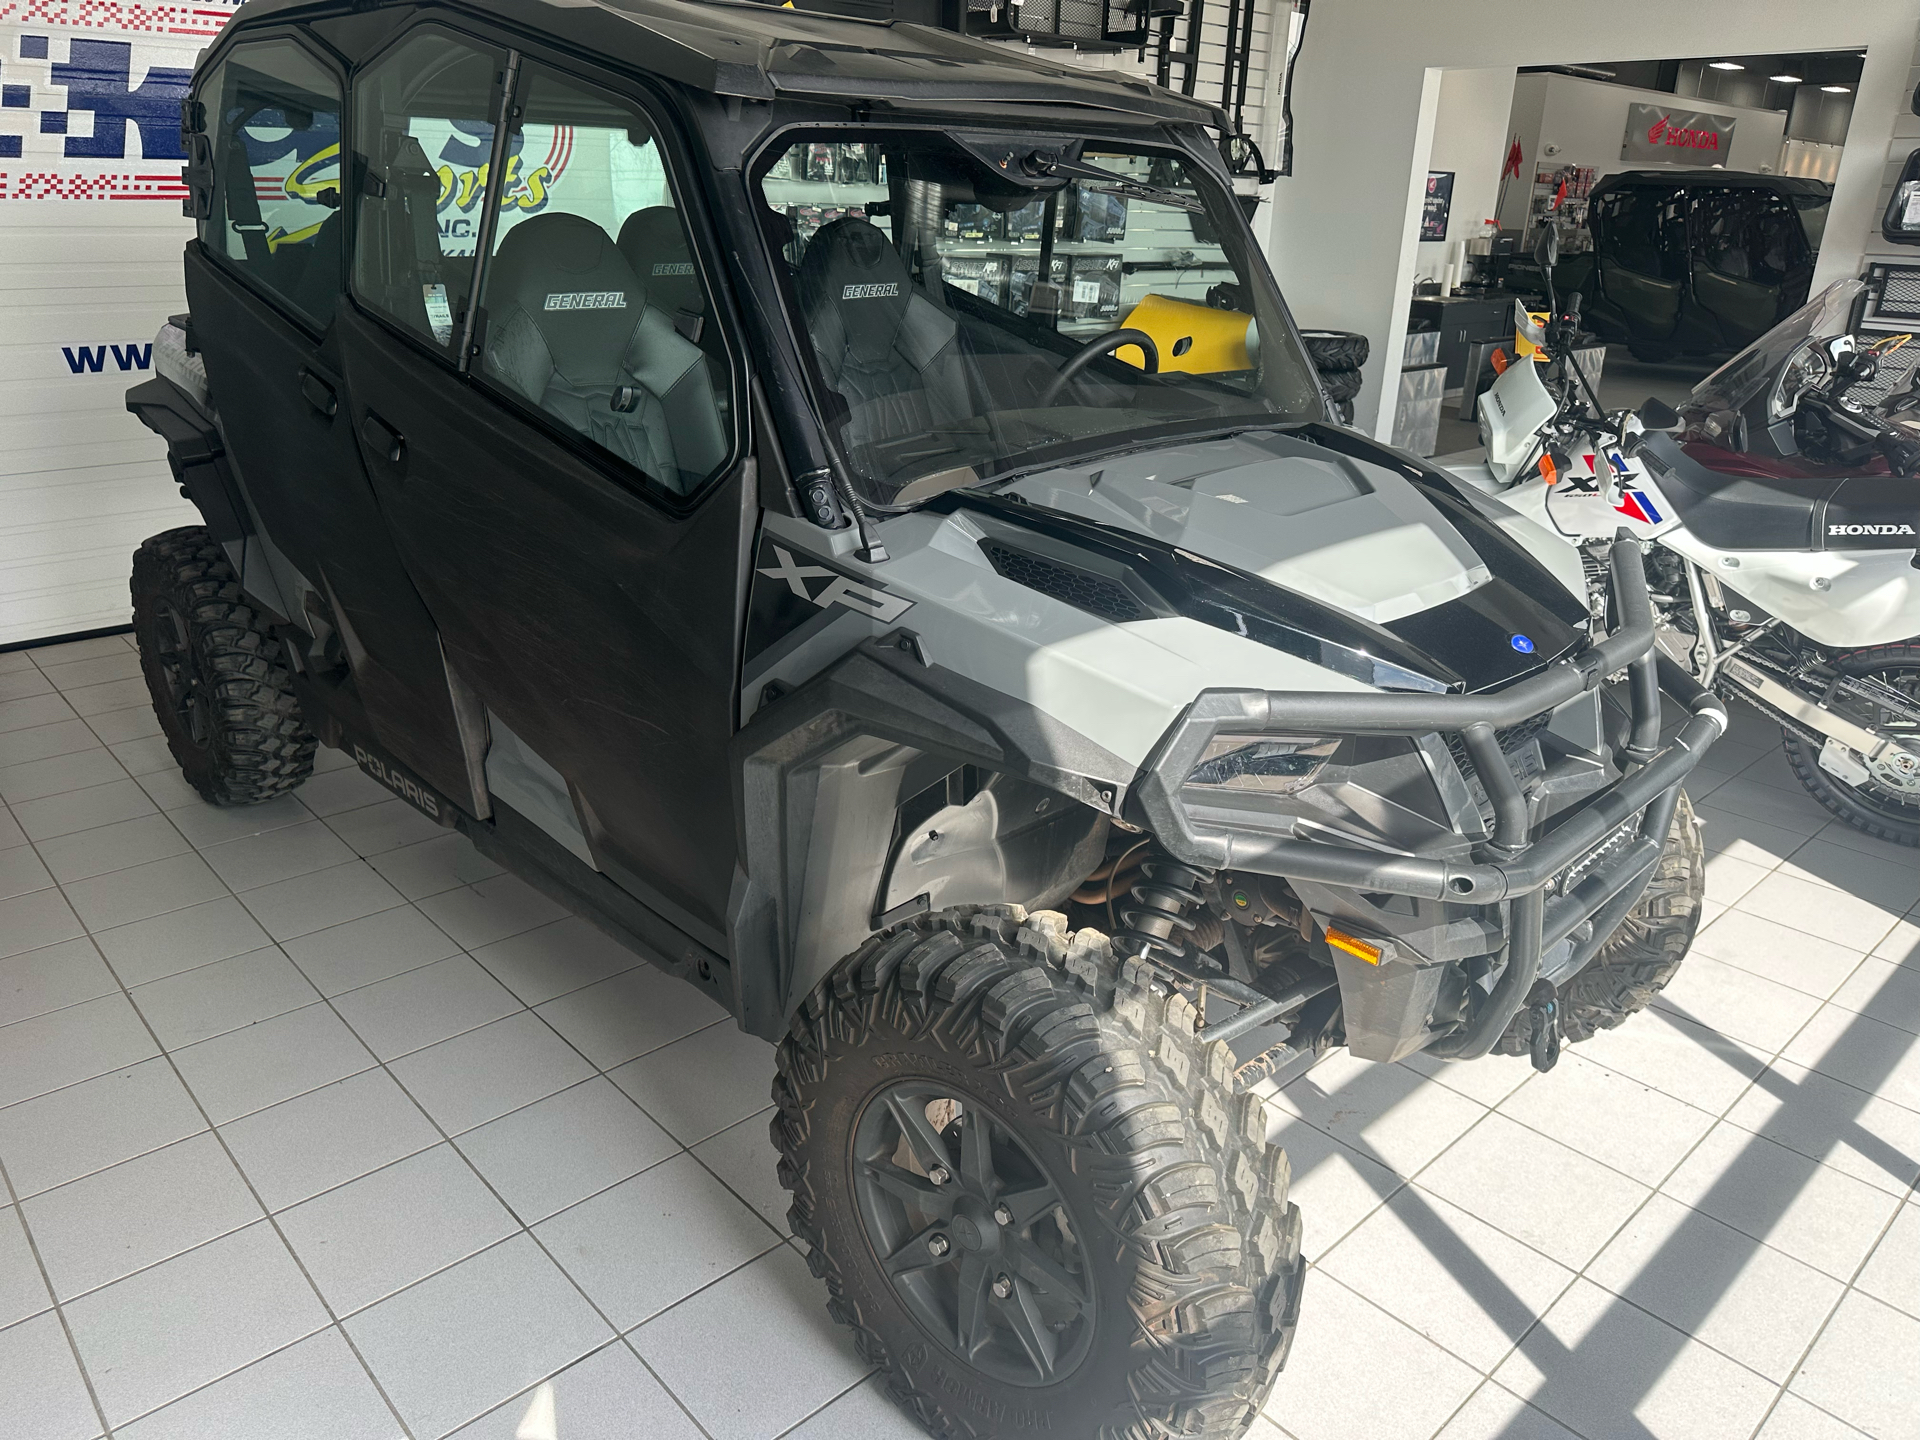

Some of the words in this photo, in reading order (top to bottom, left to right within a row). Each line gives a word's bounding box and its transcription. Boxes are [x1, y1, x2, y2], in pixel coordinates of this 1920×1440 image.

[1665, 127, 1719, 150] HONDA
[652, 263, 696, 276] GENER
[544, 291, 627, 311] GENERAL
[843, 283, 899, 300] GENERAL
[1494, 392, 1506, 417] HONDA
[1828, 524, 1916, 536] HONDA
[756, 544, 918, 624] XP
[353, 743, 439, 818] POLARIS
